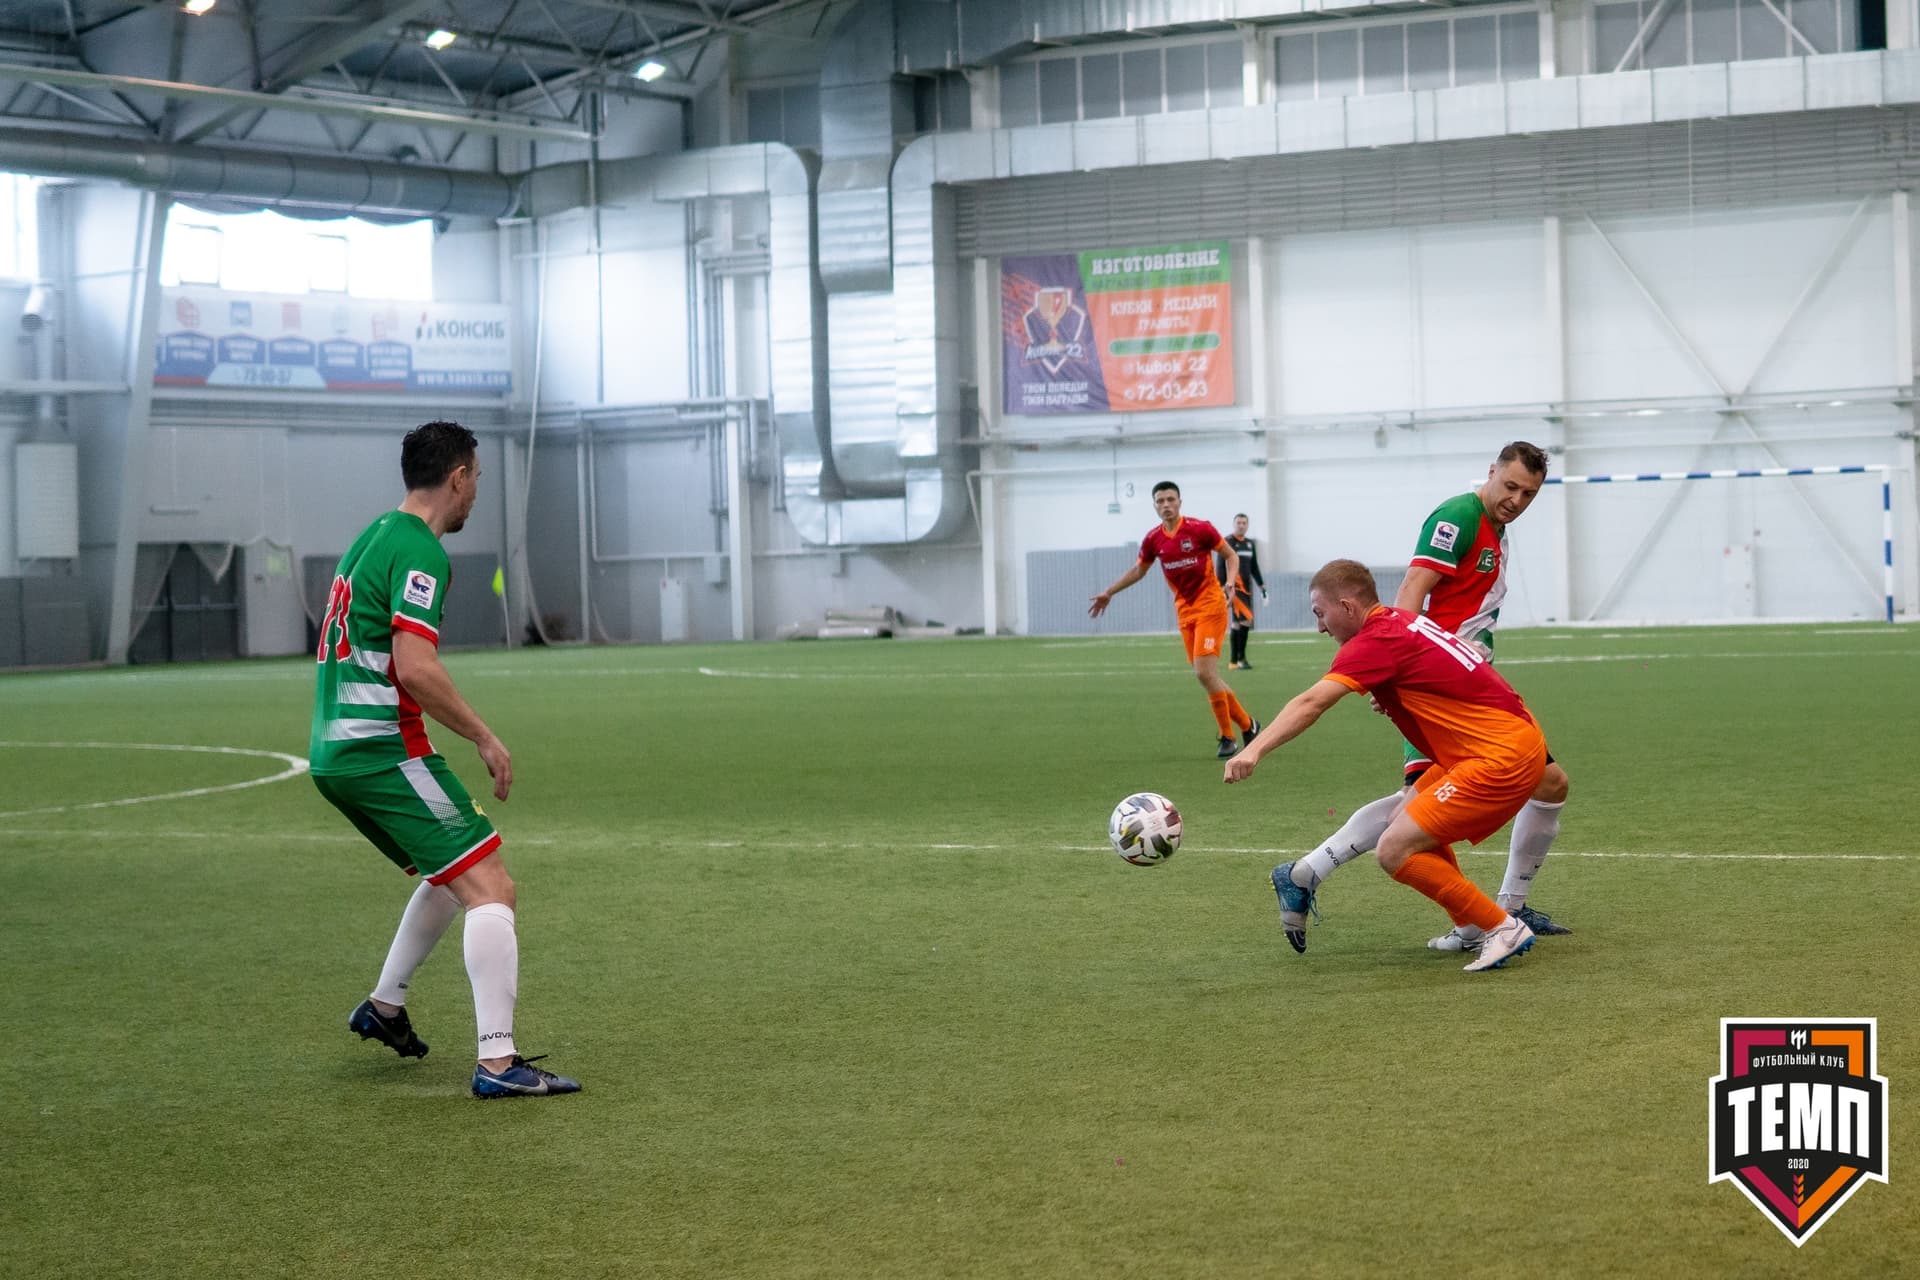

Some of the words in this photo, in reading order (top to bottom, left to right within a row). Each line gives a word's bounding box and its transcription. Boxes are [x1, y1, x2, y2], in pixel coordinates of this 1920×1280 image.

[1091, 249, 1220, 275] ИЗГОТОВЛЕНИЕ
[436, 319, 505, 339] КОНСИБ
[1137, 381, 1208, 400] 72-03-23
